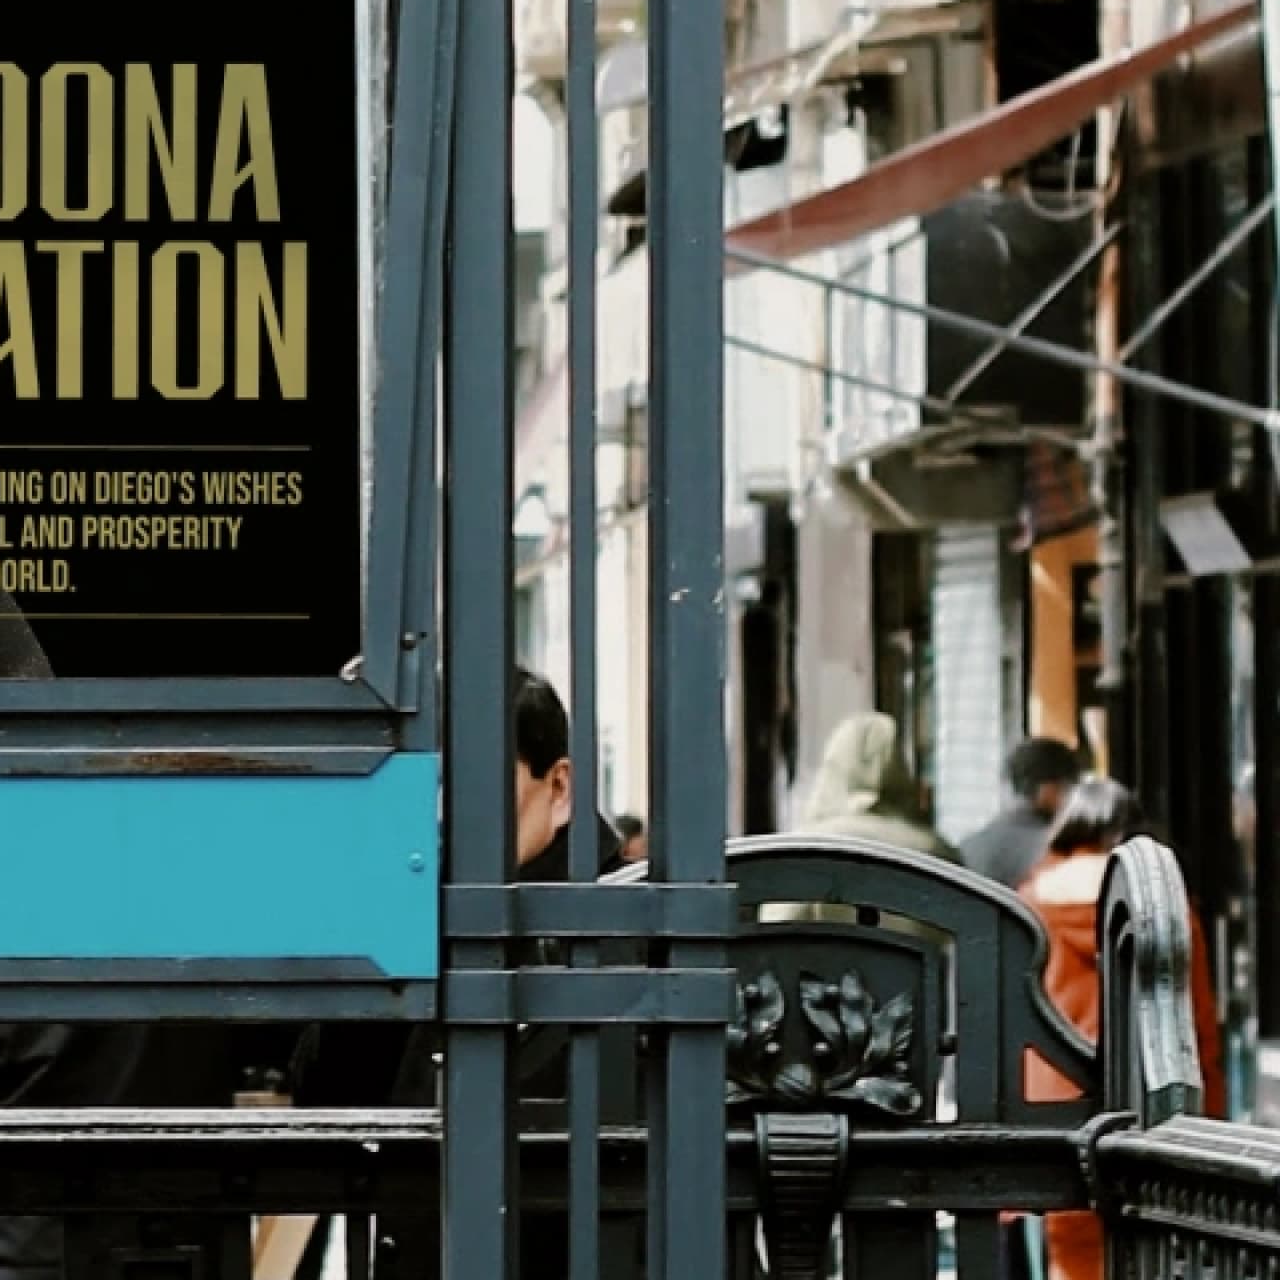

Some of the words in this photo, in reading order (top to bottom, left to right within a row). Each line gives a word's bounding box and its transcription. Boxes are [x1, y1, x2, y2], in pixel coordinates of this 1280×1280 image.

[51, 471, 87, 505] ON
[94, 471, 196, 505] DIEGO'S
[201, 471, 303, 505] WISHES
[20, 516, 74, 549] AND
[81, 516, 243, 550] PROSPERITY
